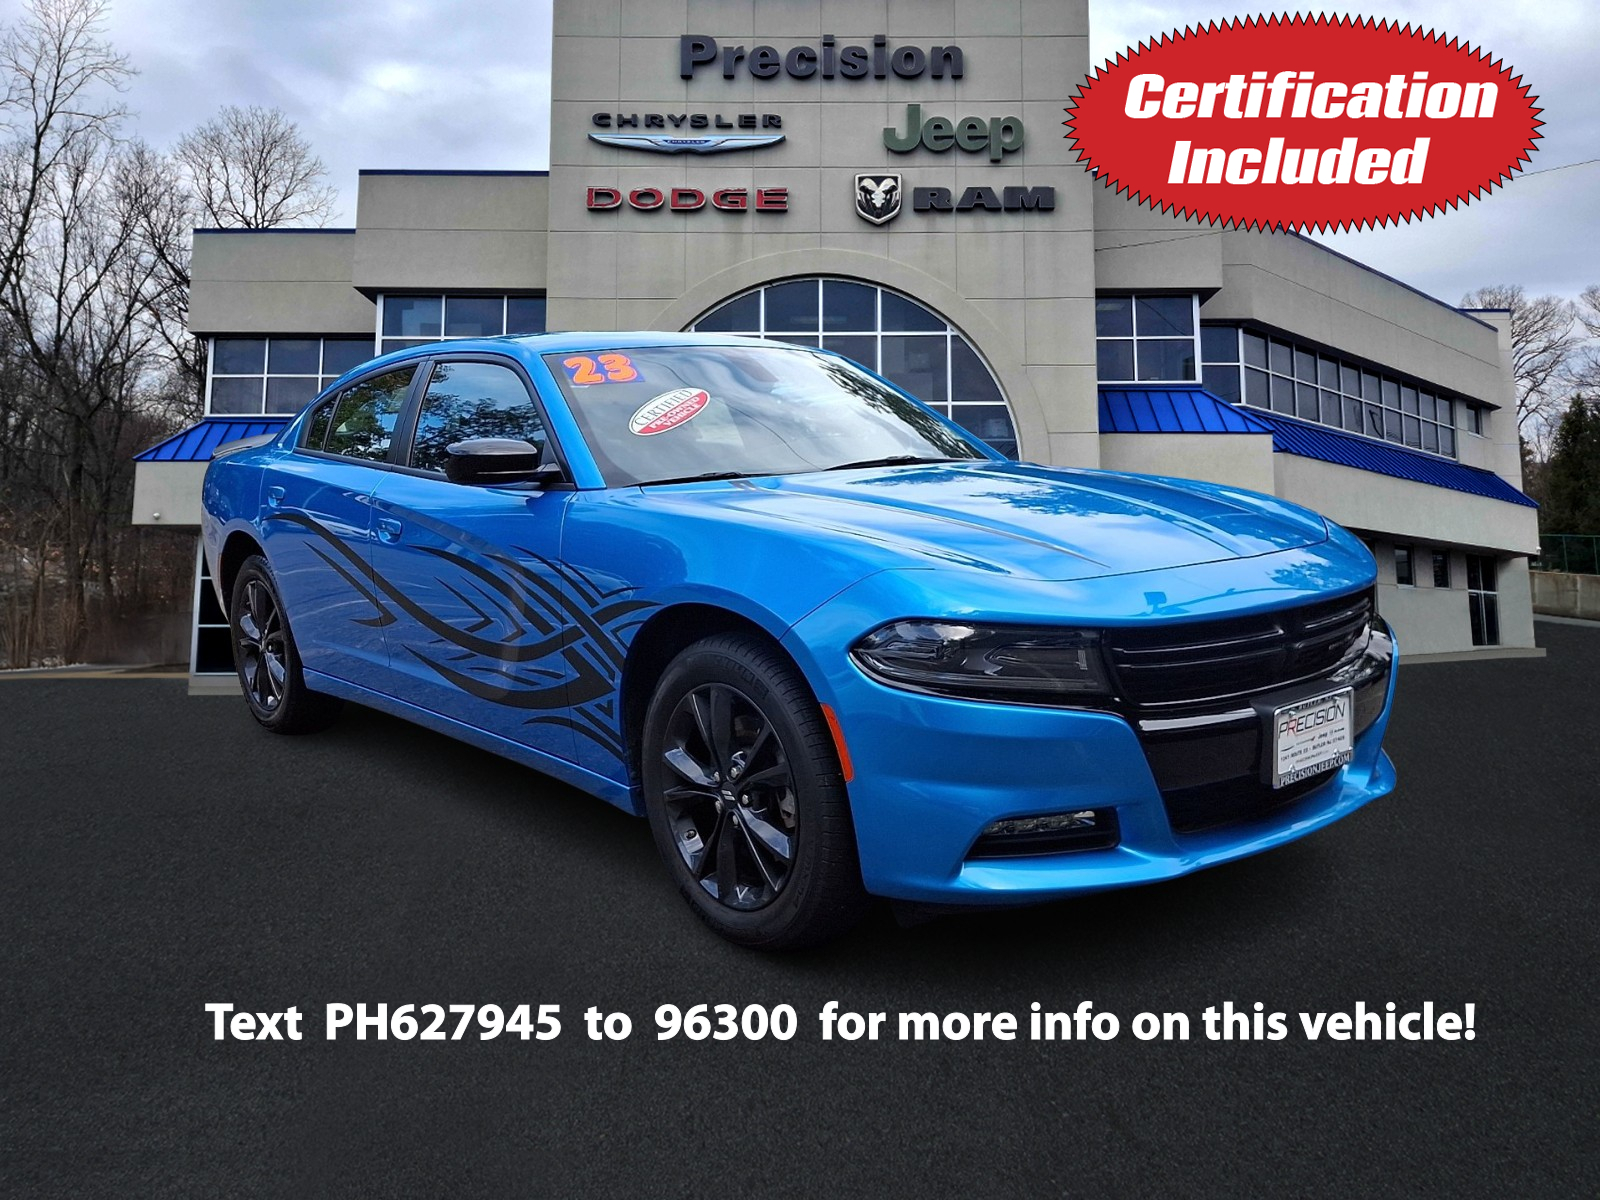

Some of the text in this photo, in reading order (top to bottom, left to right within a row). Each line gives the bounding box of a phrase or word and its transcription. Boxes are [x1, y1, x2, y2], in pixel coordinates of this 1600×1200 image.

[679, 34, 964, 80] Precision
[591, 112, 783, 129] CHRYSLER
[883, 103, 1025, 162] Jeep
[586, 186, 789, 212] DODGE
[912, 185, 1056, 212] RAM
[563, 353, 638, 384] 23
[634, 390, 693, 426] CERTIFIED
[1278, 702, 1346, 738] PRECISION
